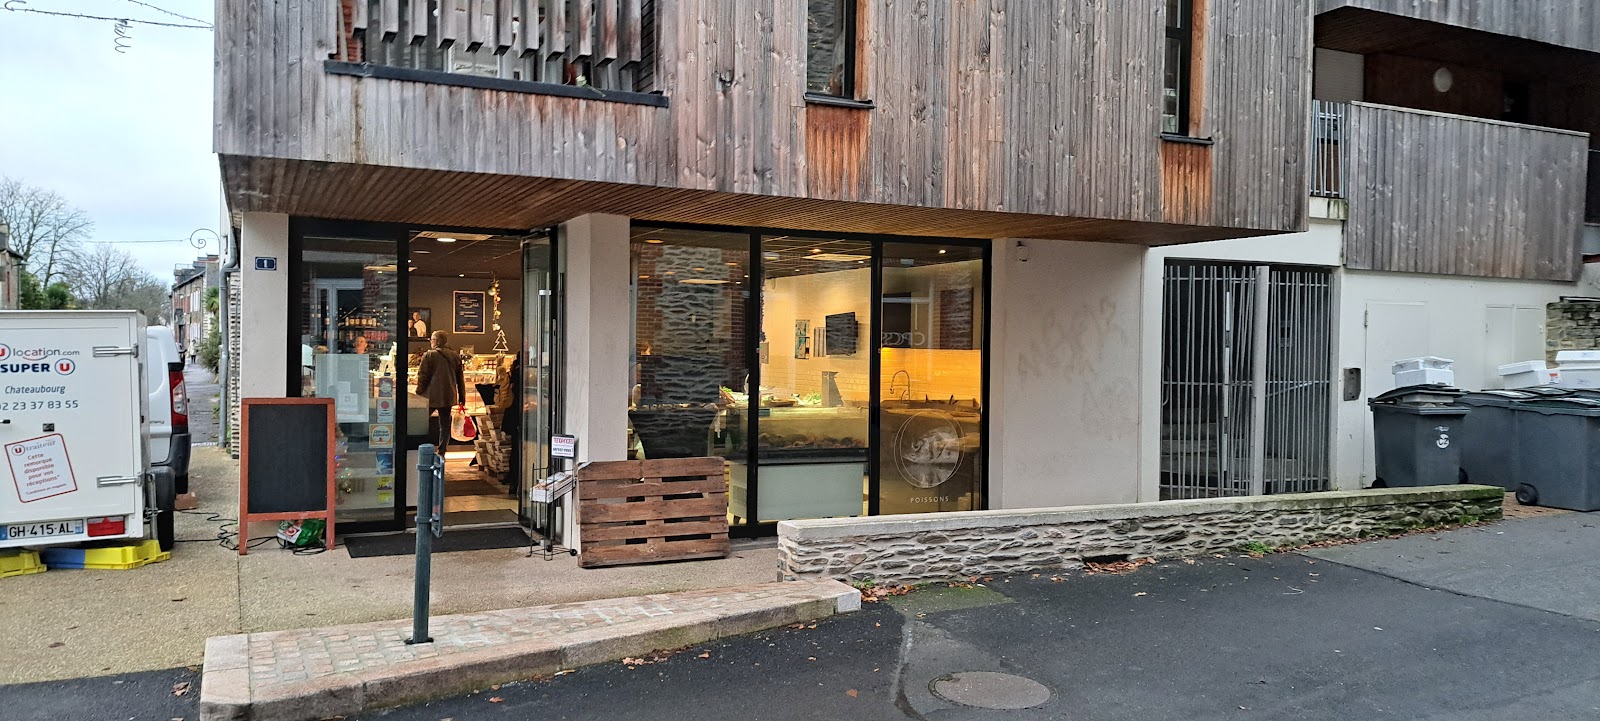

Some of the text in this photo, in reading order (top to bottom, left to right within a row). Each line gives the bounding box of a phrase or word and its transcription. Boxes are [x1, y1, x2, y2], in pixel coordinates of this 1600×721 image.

[263, 259, 268, 268] 1
[13, 348, 80, 356] location.com
[0, 363, 70, 373] SUPER U
[5, 385, 66, 394] Chateaubourg
[0, 400, 79, 411] 2 23 37 83 55
[26, 441, 56, 452] traiteur
[27, 453, 44, 461] Cette
[24, 457, 52, 468] remorque
[24, 463, 55, 475] disponible
[28, 469, 54, 481] pour vos
[910, 496, 950, 504] POISSONS
